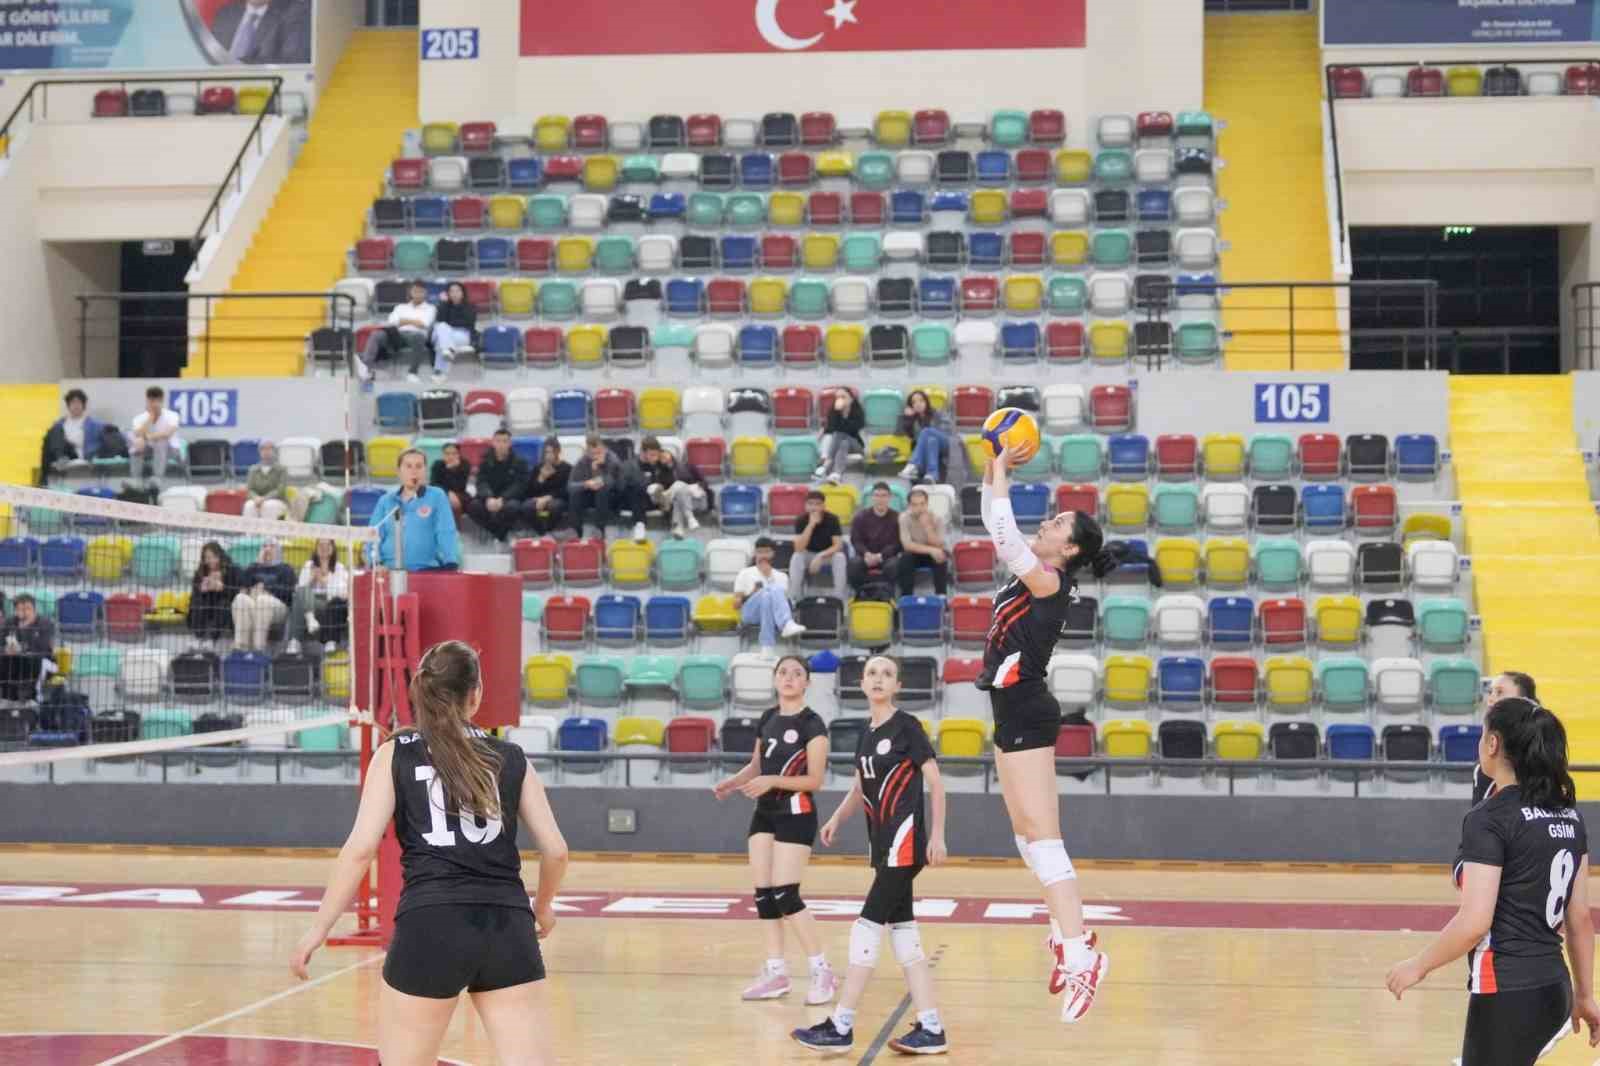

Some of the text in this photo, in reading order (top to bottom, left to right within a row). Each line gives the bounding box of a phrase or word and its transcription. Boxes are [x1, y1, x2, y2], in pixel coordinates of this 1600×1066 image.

[426, 30, 473, 59] 205
[174, 391, 229, 425] 105
[1261, 383, 1321, 419] 105
[765, 738, 777, 758] 7
[860, 756, 876, 779] 11
[1548, 821, 1575, 839] GSİM
[1545, 848, 1574, 929] 8
